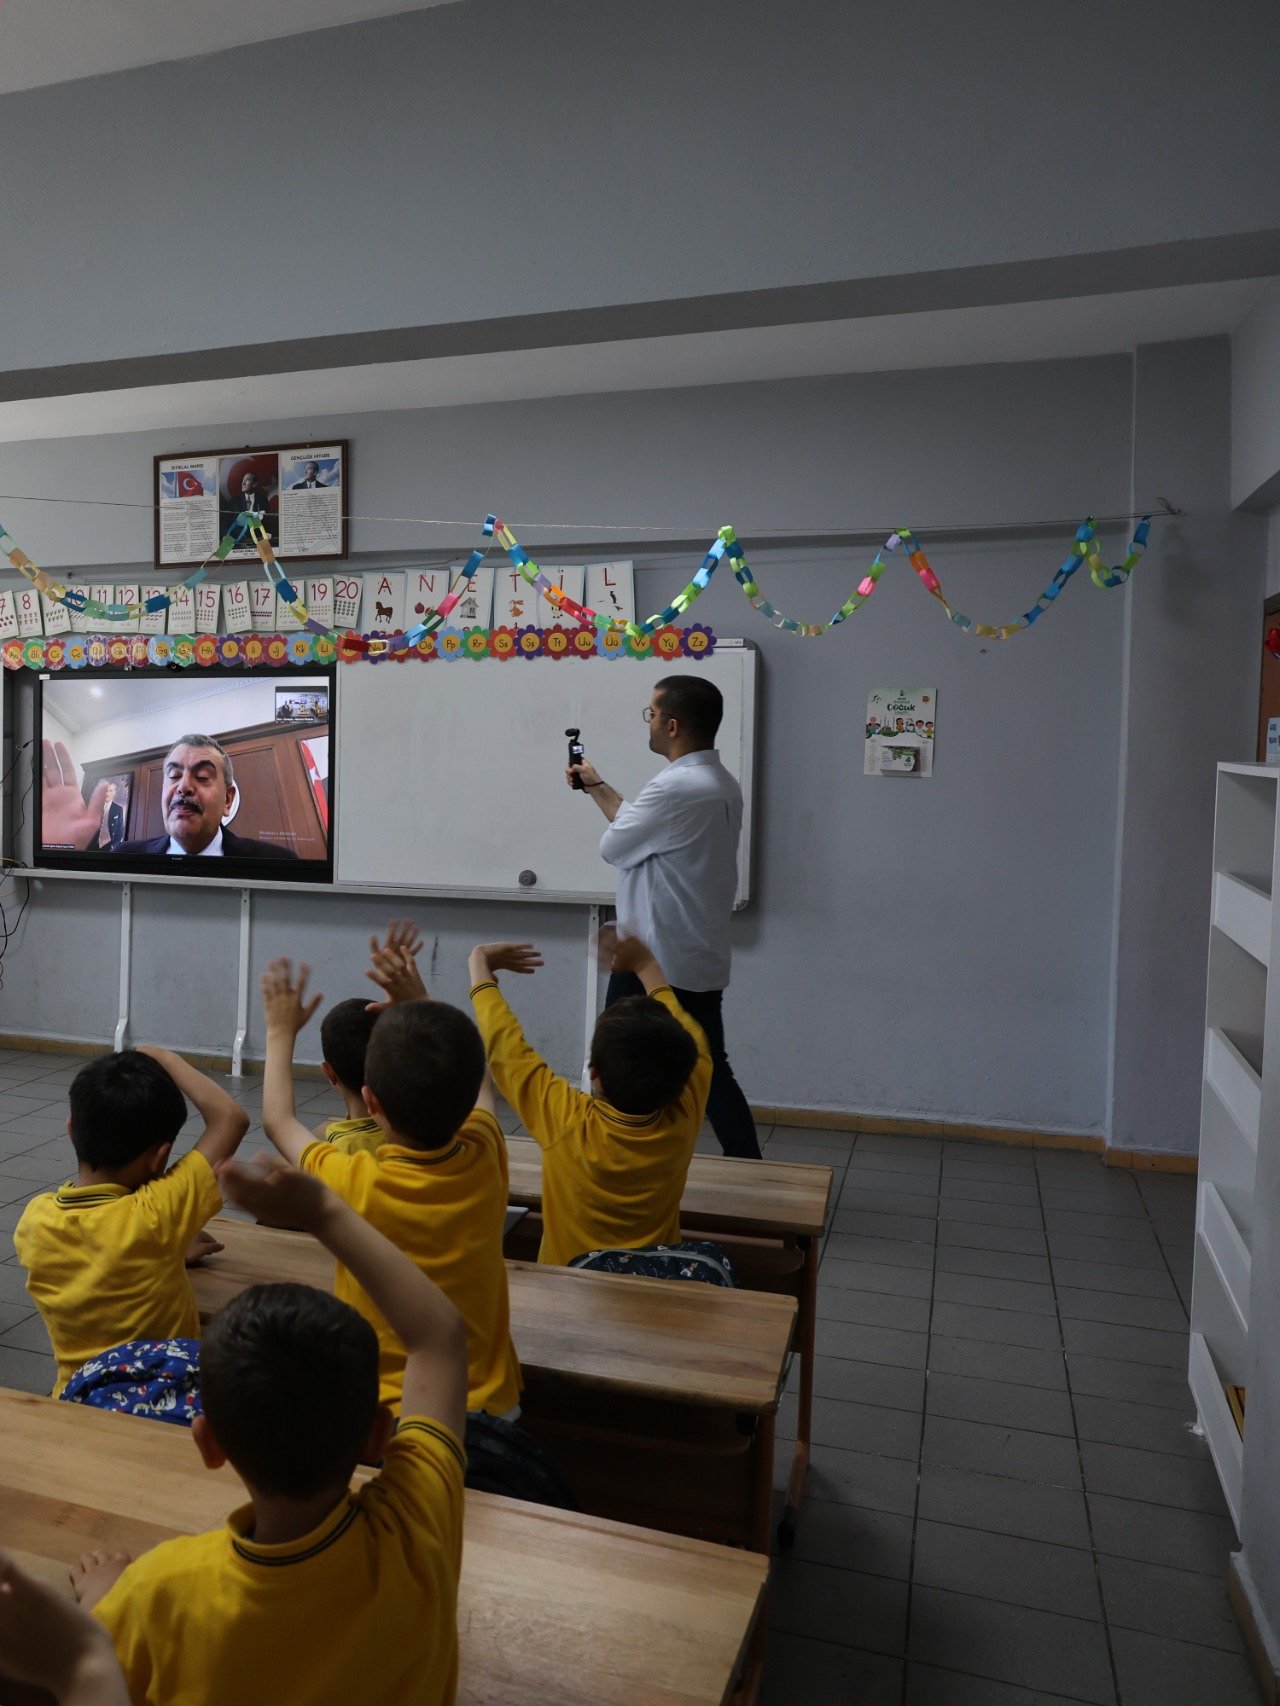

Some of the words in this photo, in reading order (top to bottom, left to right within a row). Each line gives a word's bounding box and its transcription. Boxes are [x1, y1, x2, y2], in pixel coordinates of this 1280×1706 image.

[22, 594, 31, 610] 8
[97, 589, 107, 604] 11
[119, 589, 134, 606] 12
[173, 589, 189, 607] 14
[198, 590, 216, 608] 15
[227, 586, 244, 605] 16
[254, 588, 271, 606] 17
[311, 583, 327, 601] 19
[335, 580, 358, 599] 20
[378, 577, 392, 595] A
[420, 574, 434, 592] N
[509, 574, 521, 592] T
[604, 568, 616, 586] L
[50, 651, 60, 659] Cc
[156, 646, 168, 657] Gg
[201, 646, 213, 654] Hh
[273, 646, 280, 657] Jj
[295, 644, 305, 653] Kk
[446, 639, 456, 651] Pp
[472, 639, 482, 648] Rr
[499, 639, 508, 648] Ss
[553, 637, 562, 647] Tt
[578, 637, 590, 647] Uu
[634, 638, 646, 647] Vv
[662, 638, 674, 651] Yy
[691, 637, 704, 647] Zz
